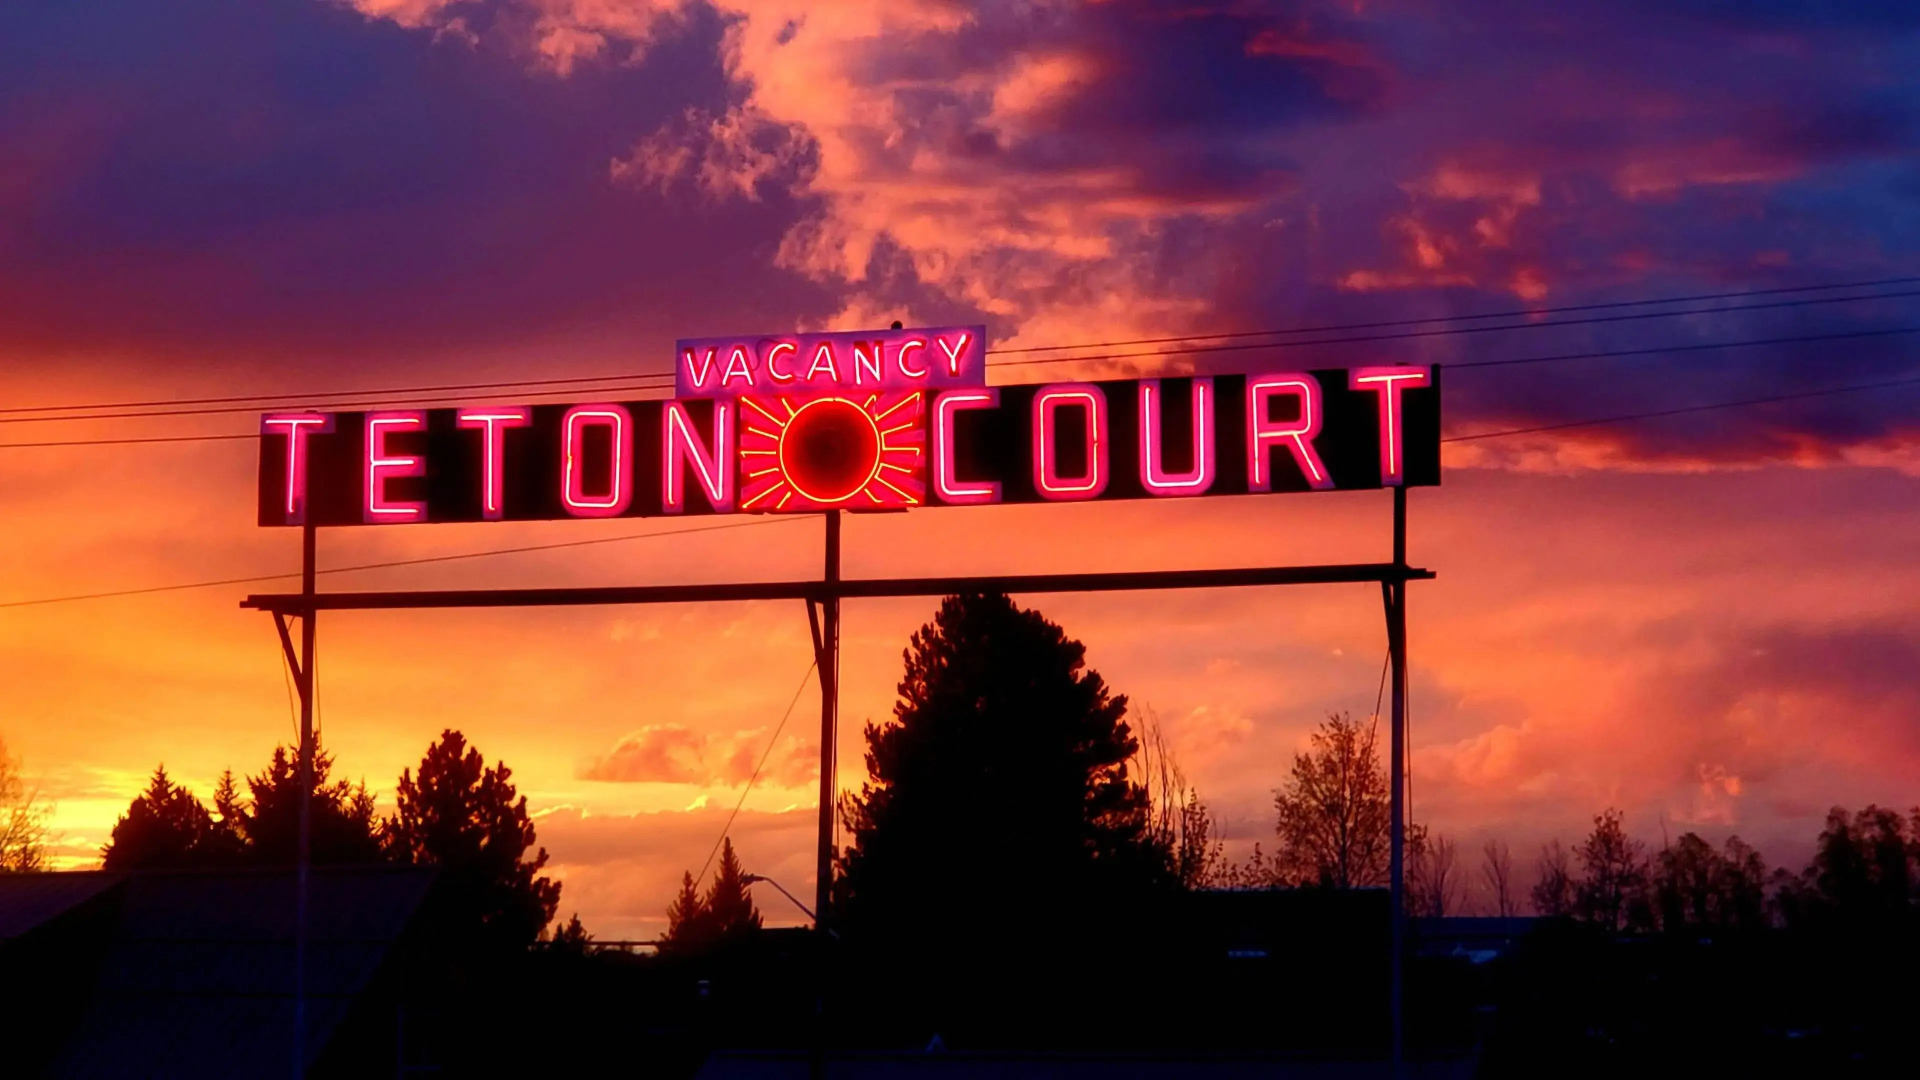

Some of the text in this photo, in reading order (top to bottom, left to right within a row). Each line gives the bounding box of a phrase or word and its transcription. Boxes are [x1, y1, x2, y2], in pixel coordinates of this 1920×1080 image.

[683, 334, 971, 389] VACANCY
[262, 366, 1431, 523] TETON COURT
